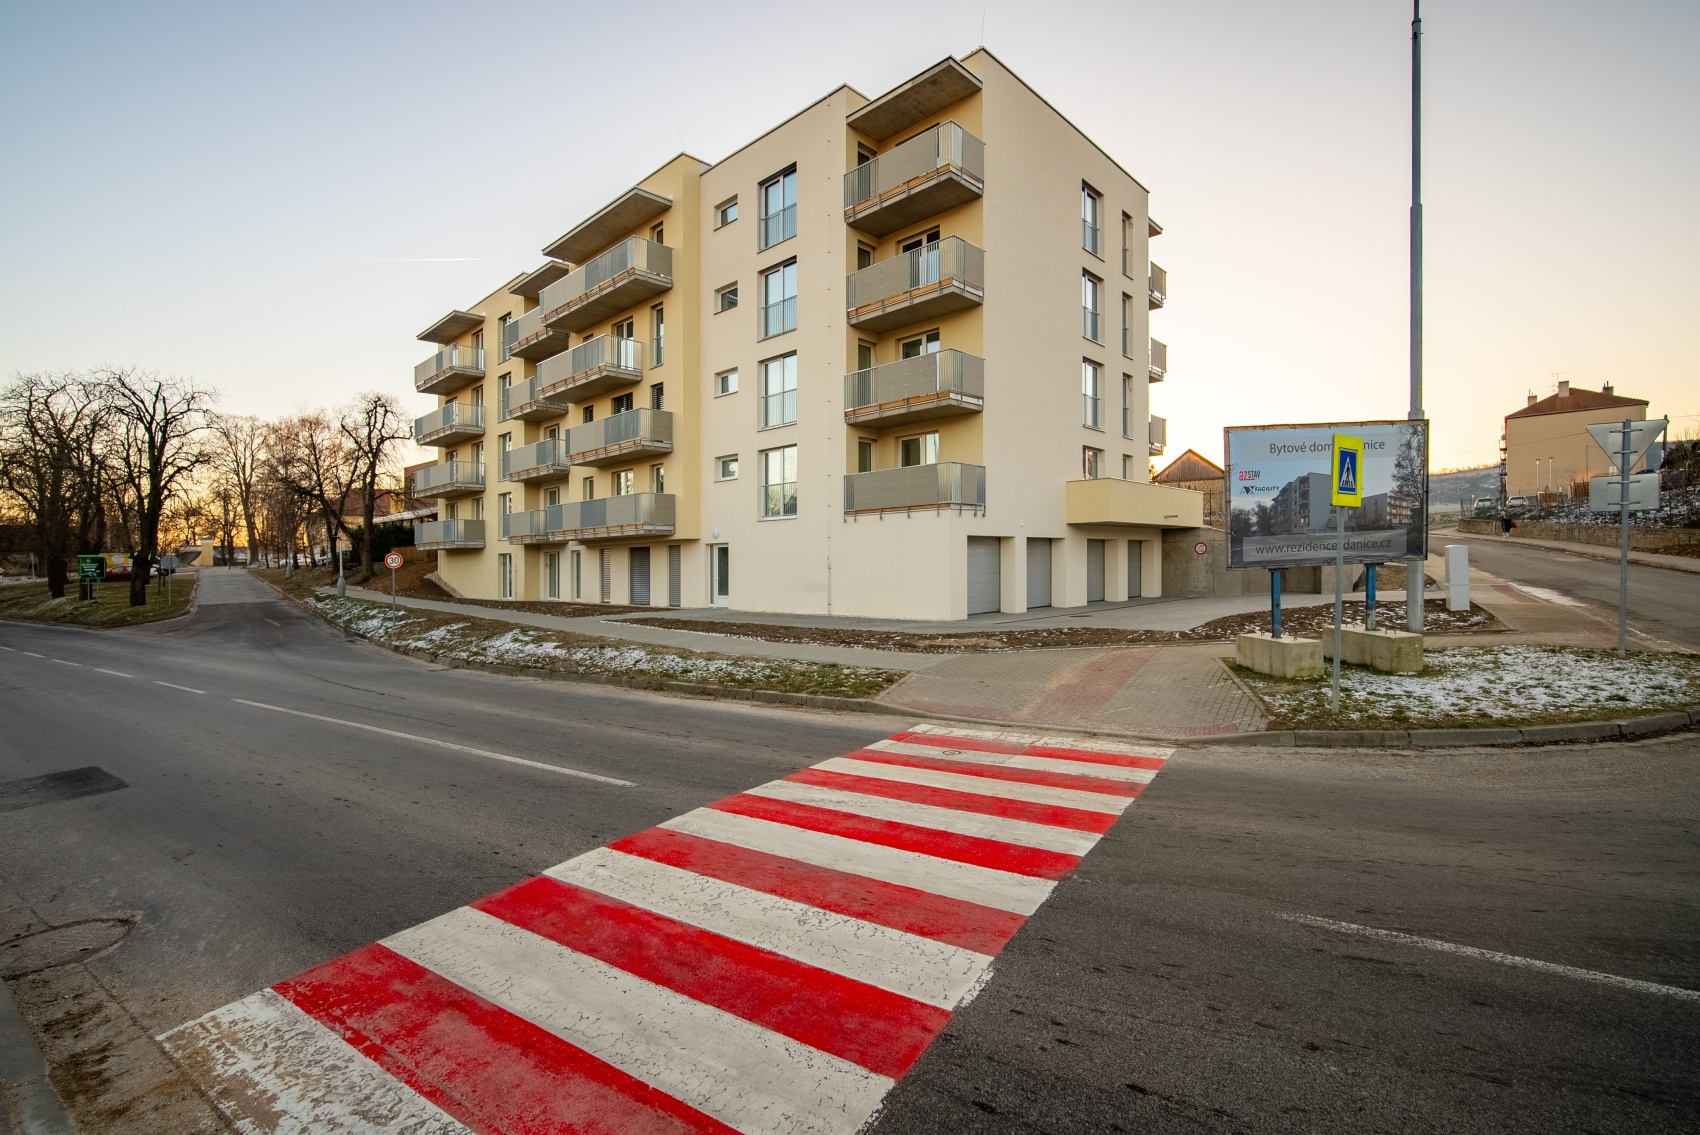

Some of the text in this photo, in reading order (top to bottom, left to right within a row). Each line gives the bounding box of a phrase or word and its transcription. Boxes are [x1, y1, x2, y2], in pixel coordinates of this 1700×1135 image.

[1269, 442, 1307, 456] Bytové
[1309, 441, 1332, 452] dom
[1255, 539, 1391, 554] www.rezidencedanice.cz
